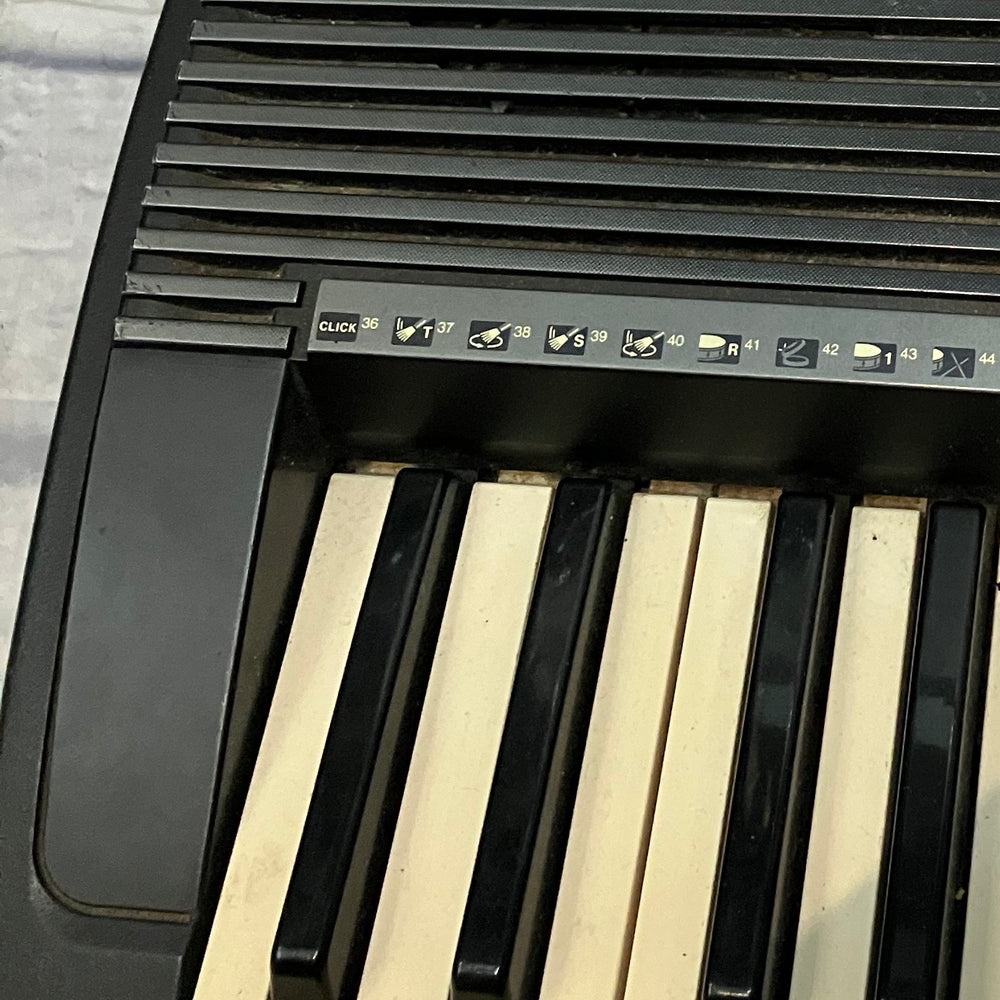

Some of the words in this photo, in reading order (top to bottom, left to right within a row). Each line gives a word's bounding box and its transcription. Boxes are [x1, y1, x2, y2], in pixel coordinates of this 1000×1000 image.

[319, 321, 356, 332] CLICK
[362, 318, 378, 329] 36
[437, 322, 454, 333] 37
[514, 326, 531, 338] 38
[591, 330, 607, 342] 39
[667, 335, 684, 346] 40
[745, 340, 759, 350] 41
[823, 344, 839, 355] 42
[900, 348, 917, 360] 43
[979, 353, 995, 364] 44
